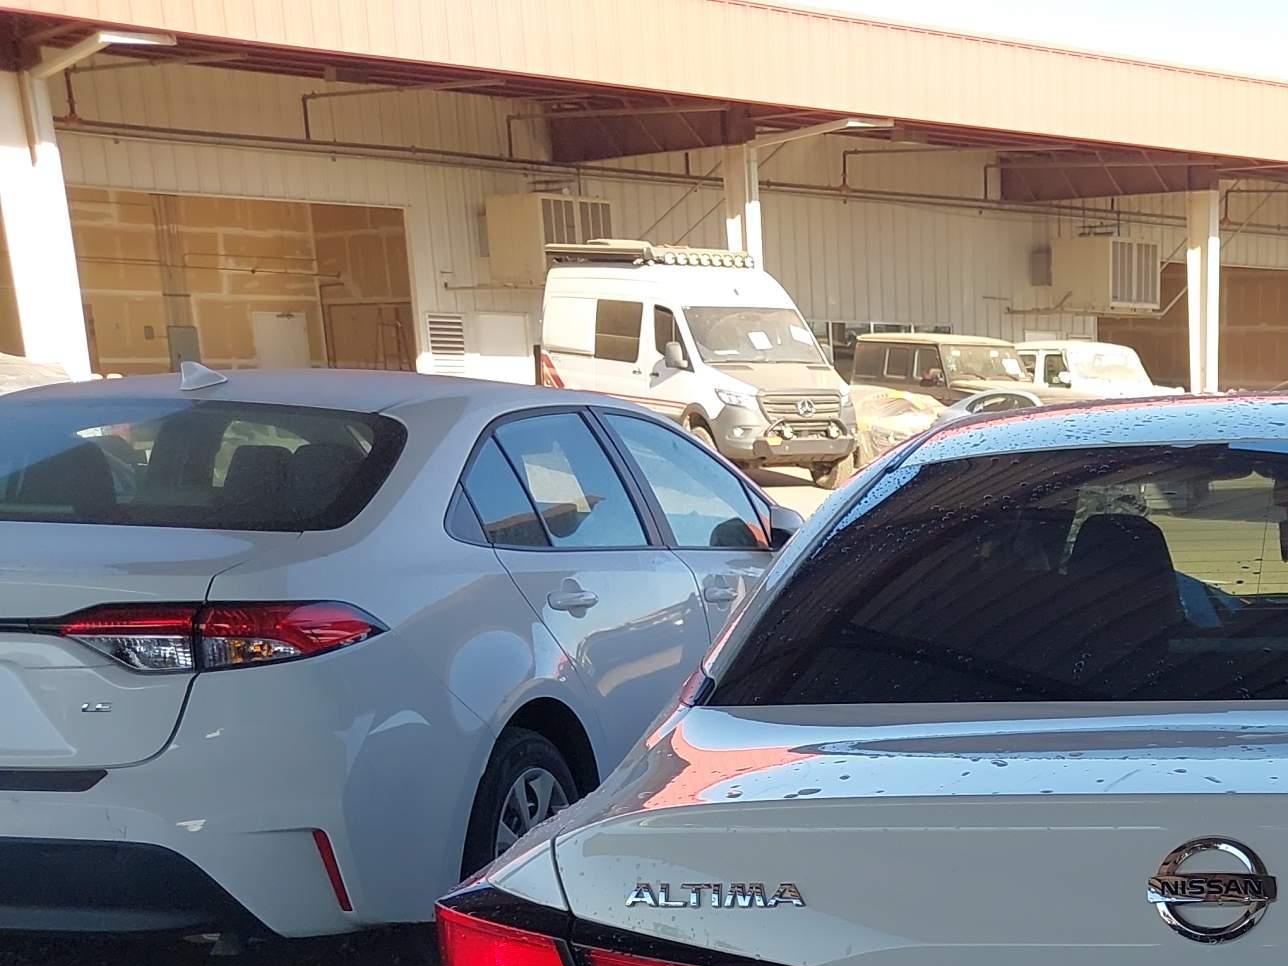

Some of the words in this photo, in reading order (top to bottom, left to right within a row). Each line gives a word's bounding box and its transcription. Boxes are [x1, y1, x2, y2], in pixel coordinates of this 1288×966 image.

[81, 702, 112, 713] LE
[625, 881, 807, 910] ALTIMA
[1160, 878, 1264, 896] NISSAN
